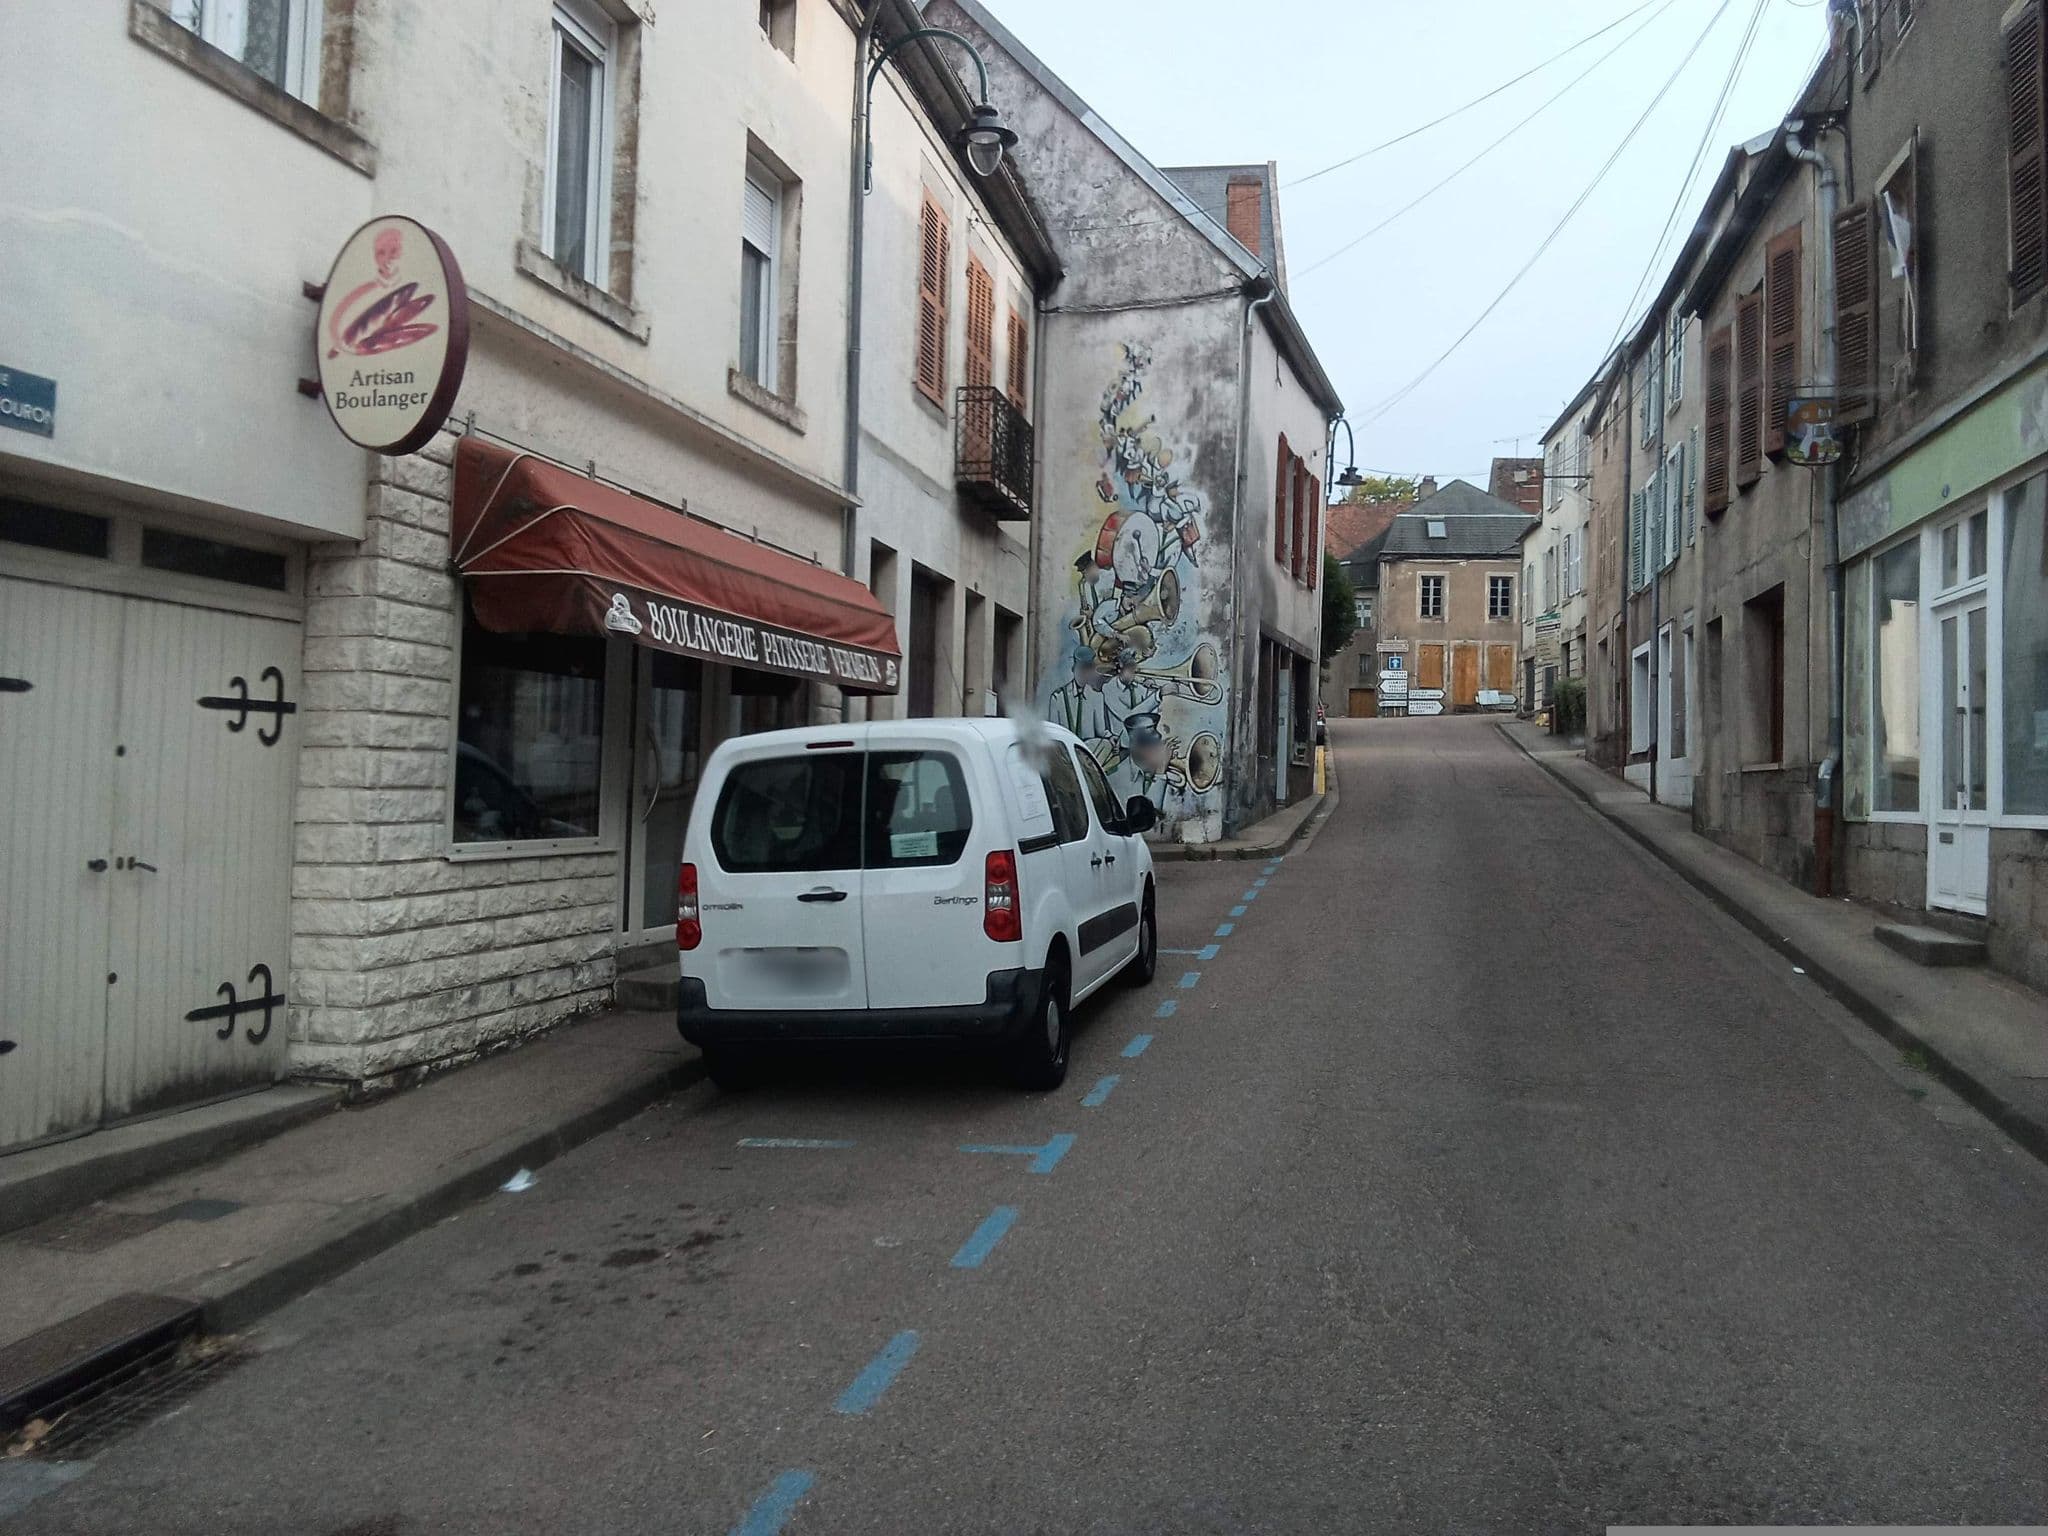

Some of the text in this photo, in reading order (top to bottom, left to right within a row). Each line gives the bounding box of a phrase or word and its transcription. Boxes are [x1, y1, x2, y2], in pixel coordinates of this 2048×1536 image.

[349, 369, 414, 387] Artisan
[336, 389, 428, 410] Boulanger
[646, 601, 759, 661] BOULANGERIE
[761, 631, 830, 674] PATISSERIE
